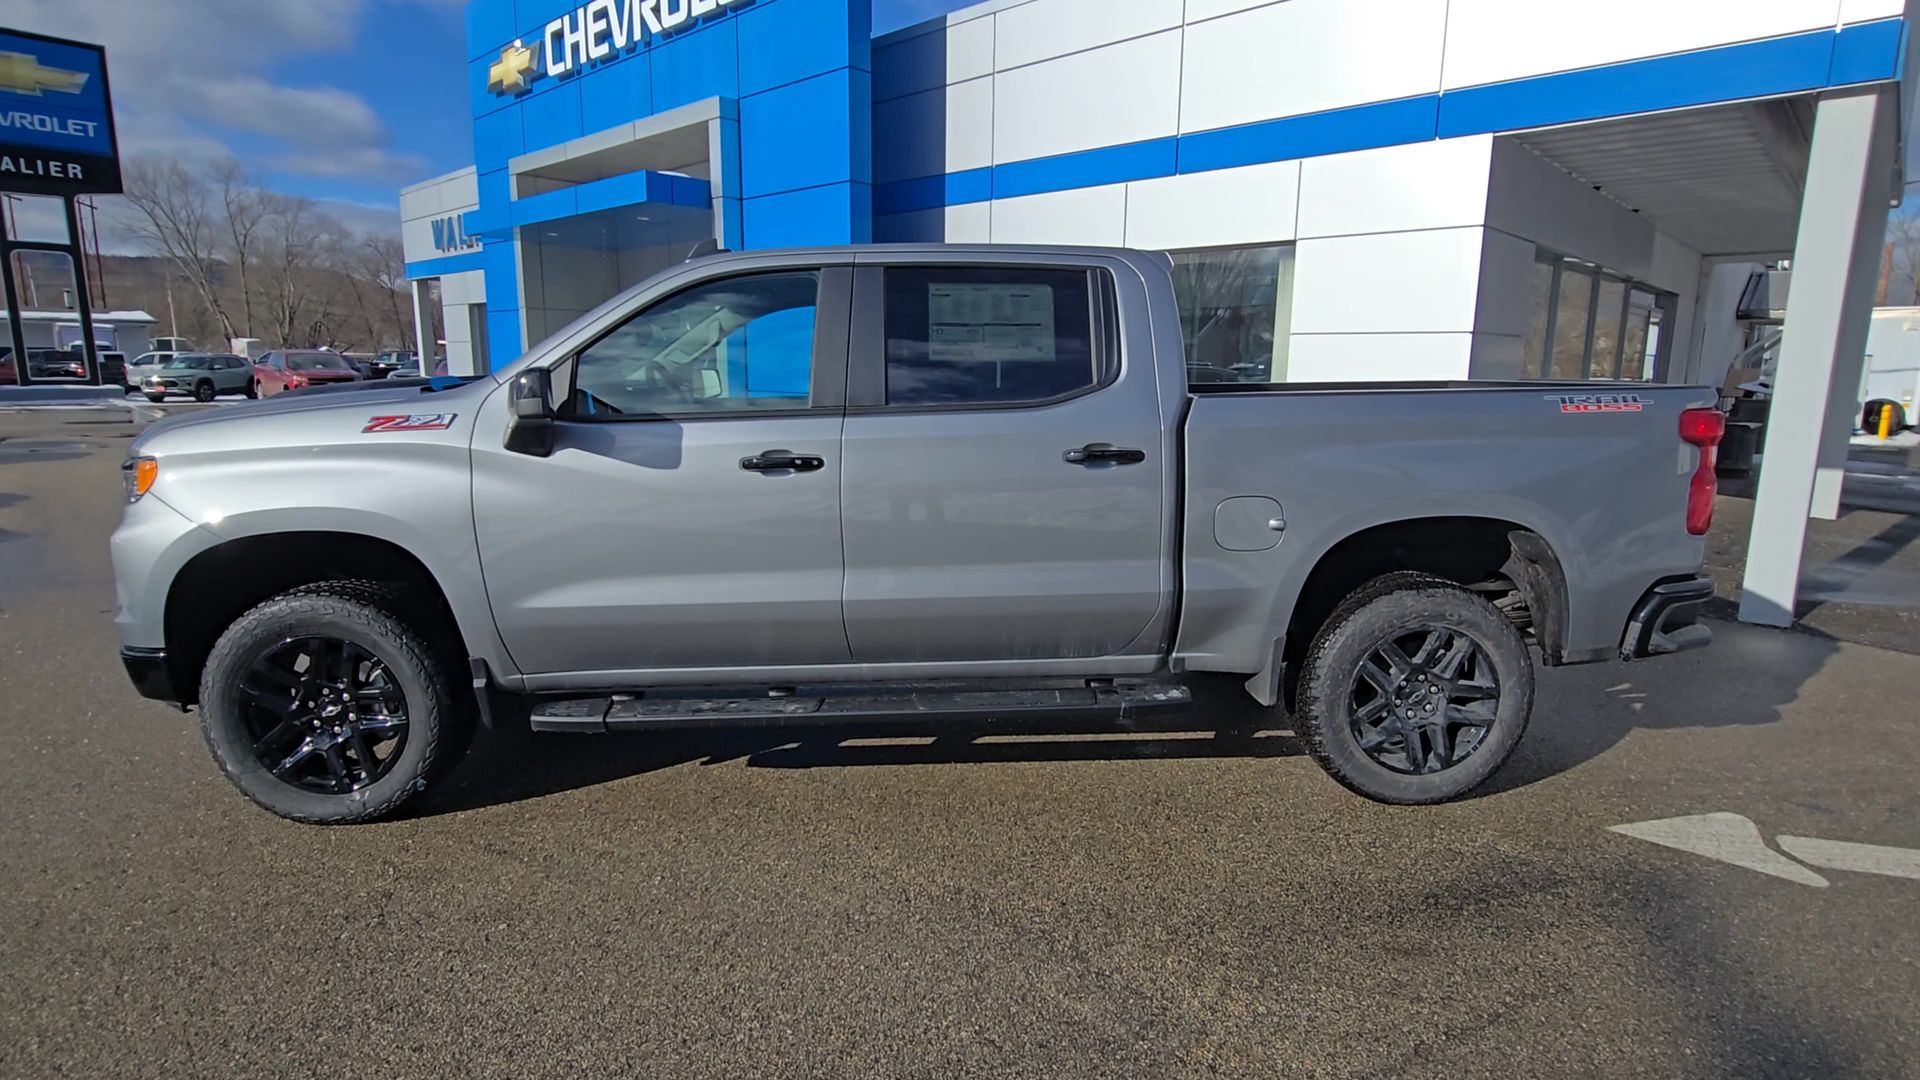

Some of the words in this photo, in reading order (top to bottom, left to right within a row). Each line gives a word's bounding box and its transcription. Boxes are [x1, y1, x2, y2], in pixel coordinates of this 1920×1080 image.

[544, 0, 736, 77] CHEVRO
[0, 156, 83, 180] ALIER
[431, 214, 482, 251] WAL
[1561, 403, 1642, 413] BOSS
[360, 412, 458, 434] Z71
